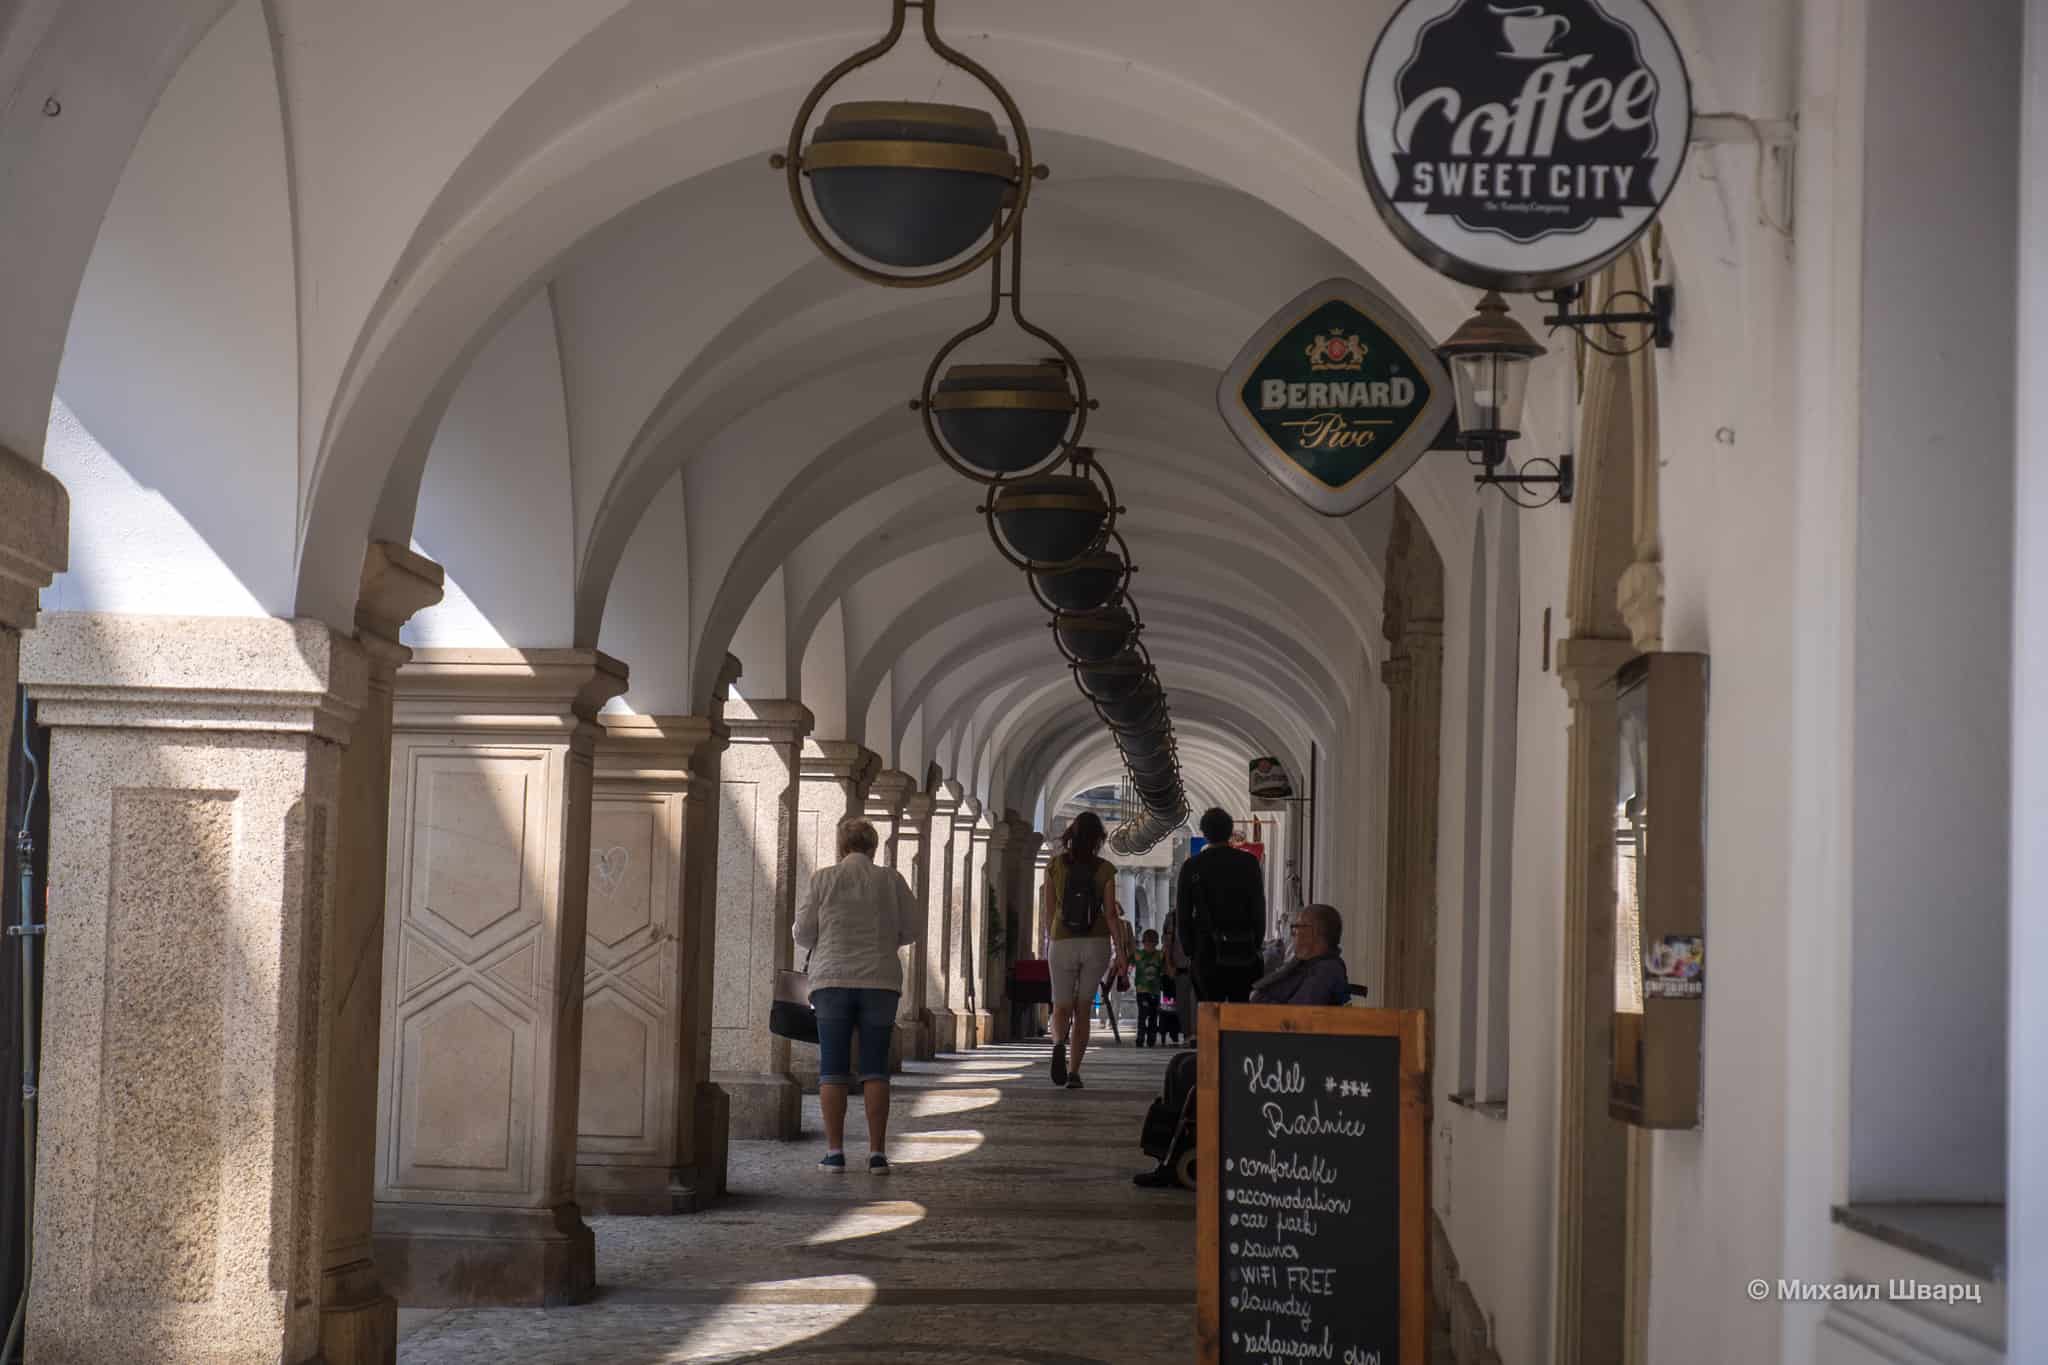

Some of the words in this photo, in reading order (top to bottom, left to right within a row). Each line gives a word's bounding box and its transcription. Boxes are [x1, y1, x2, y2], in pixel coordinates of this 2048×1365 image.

[1397, 54, 1654, 156] Coffee
[1413, 161, 1537, 197] SWEET
[1550, 163, 1635, 198] CITY
[1260, 377, 1415, 410] BERNARD
[1243, 1053, 1305, 1094] Hotel
[1262, 1099, 1366, 1138] Radnice
[1239, 1149, 1338, 1183] comfortable
[1236, 1187, 1351, 1214] accomodation
[1240, 1213, 1268, 1228] car
[1277, 1211, 1318, 1243] park
[1241, 1240, 1300, 1258] sauna
[1240, 1266, 1277, 1289] WIFI
[1287, 1266, 1337, 1295] FREE
[1240, 1287, 1313, 1331] laundry
[1244, 1320, 1333, 1360] restaurant
